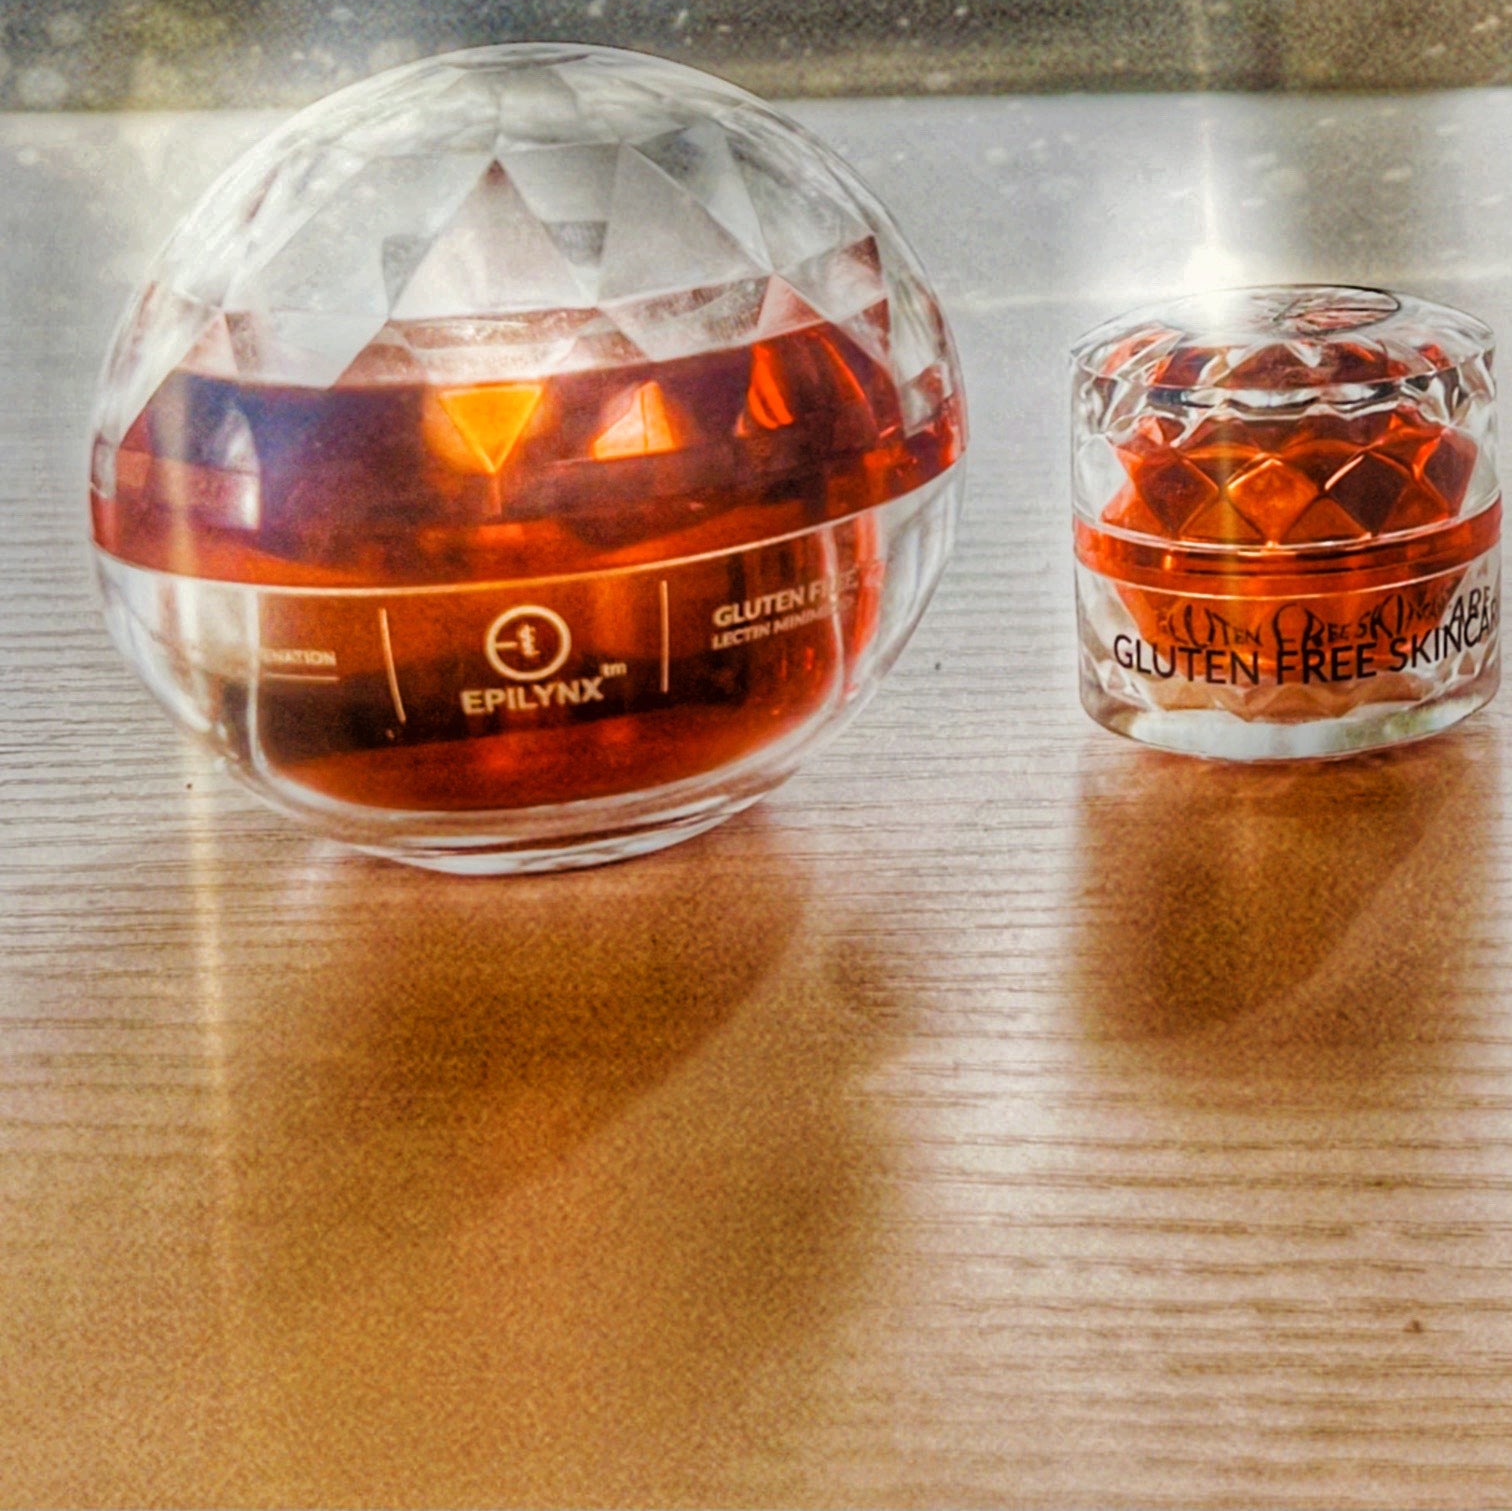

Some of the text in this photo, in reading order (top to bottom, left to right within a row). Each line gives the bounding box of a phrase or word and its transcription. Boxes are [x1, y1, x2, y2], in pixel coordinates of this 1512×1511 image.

[712, 585, 805, 628] GLUTEN
[1114, 634, 1259, 686] GLUTEN
[1276, 642, 1377, 686] FREE
[460, 675, 604, 717] EPILYNX
